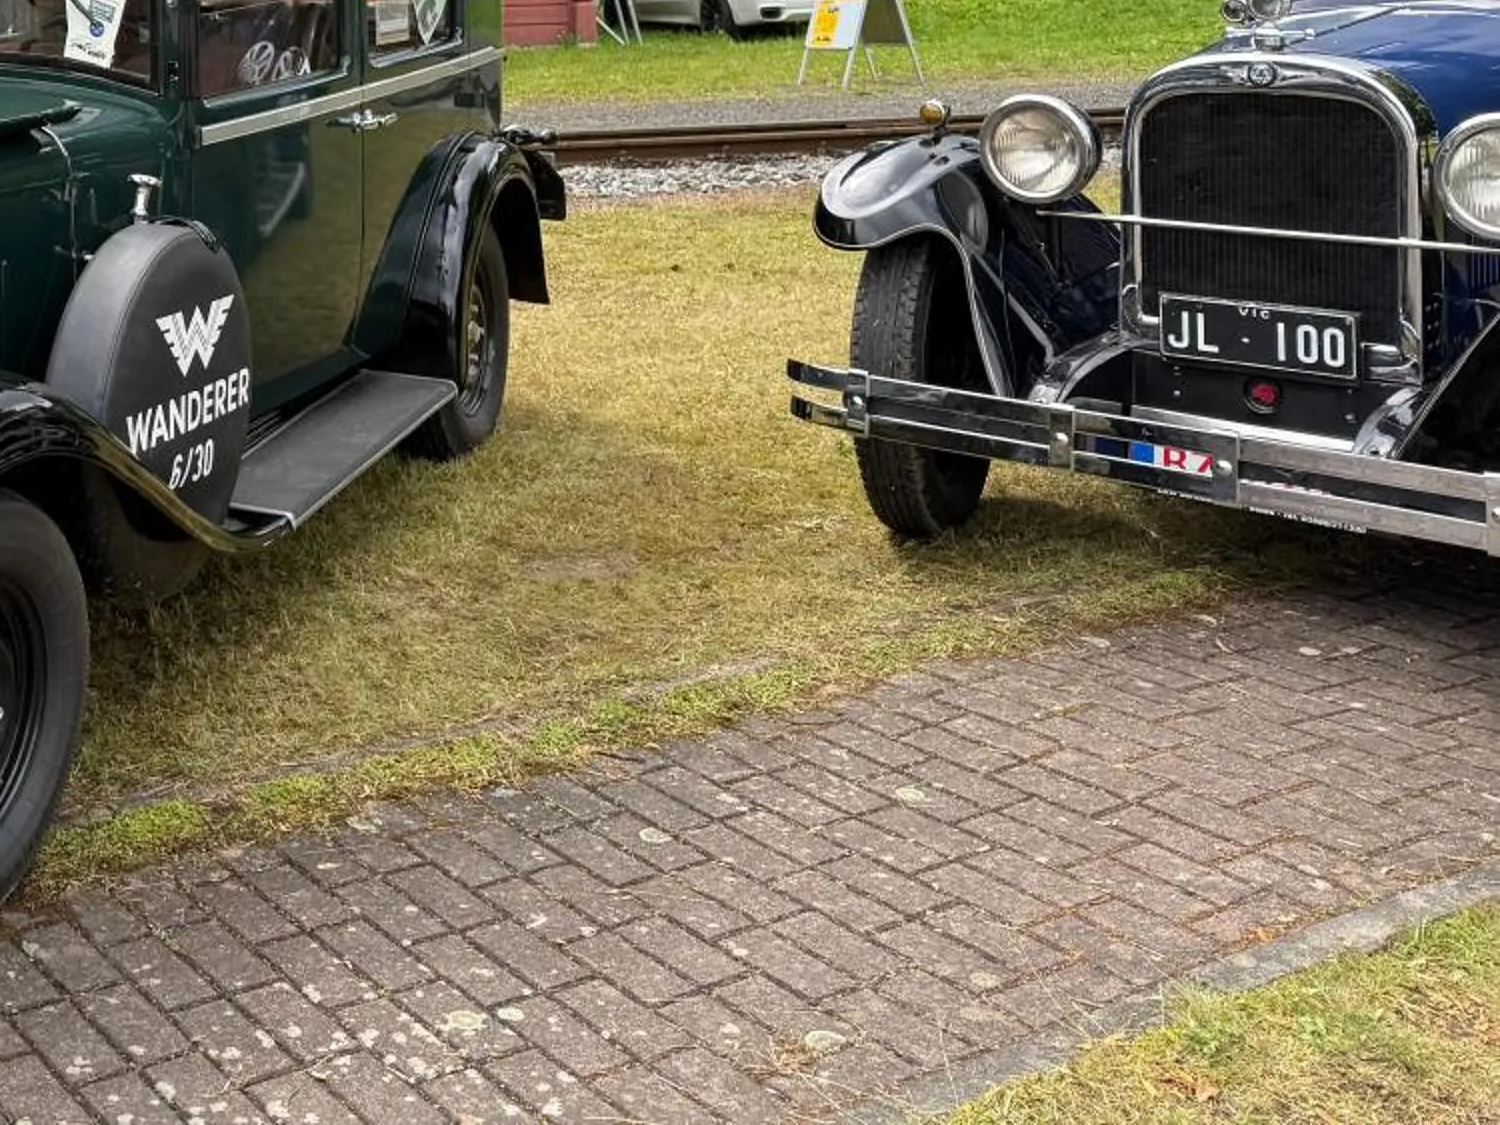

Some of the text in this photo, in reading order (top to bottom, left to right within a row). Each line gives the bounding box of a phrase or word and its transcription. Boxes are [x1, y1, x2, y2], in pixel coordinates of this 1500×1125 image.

[1167, 310, 1346, 369] JL 100
[125, 368, 250, 455] WANDERER
[168, 438, 215, 491] 6/30
